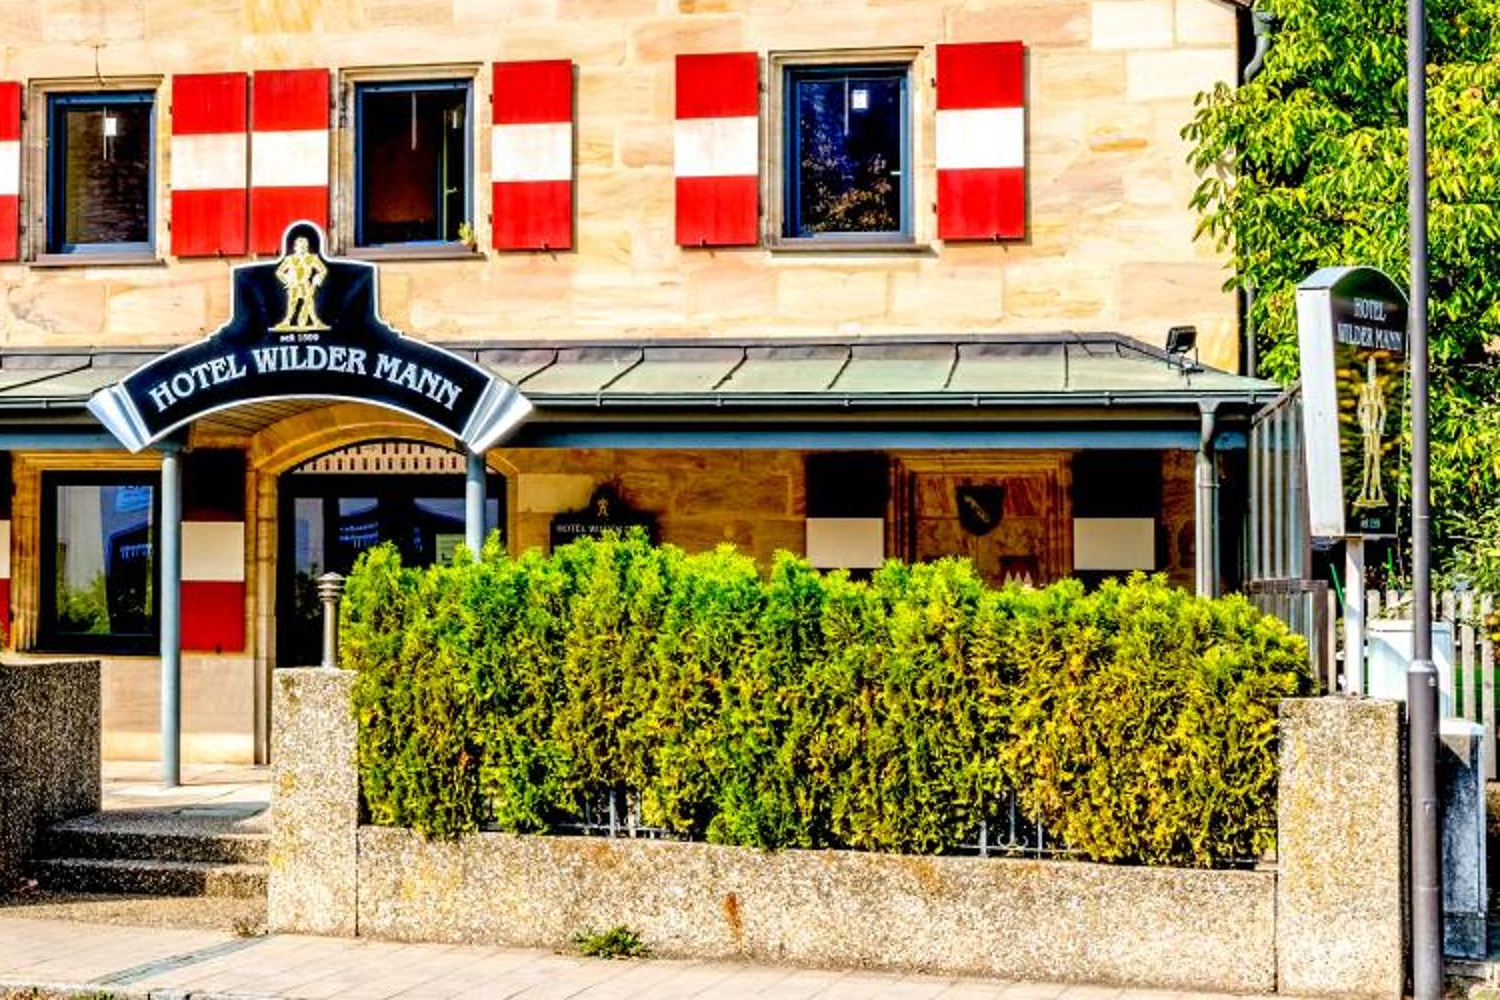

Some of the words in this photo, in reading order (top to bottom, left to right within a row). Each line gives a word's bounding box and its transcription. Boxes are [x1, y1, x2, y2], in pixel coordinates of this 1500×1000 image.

[1354, 297, 1387, 321] HOTEL
[1337, 323, 1374, 347] WILDER
[1375, 328, 1403, 351] MANN
[148, 354, 247, 412] HOTEL
[252, 345, 367, 375] WILDER
[373, 353, 463, 411] MANN
